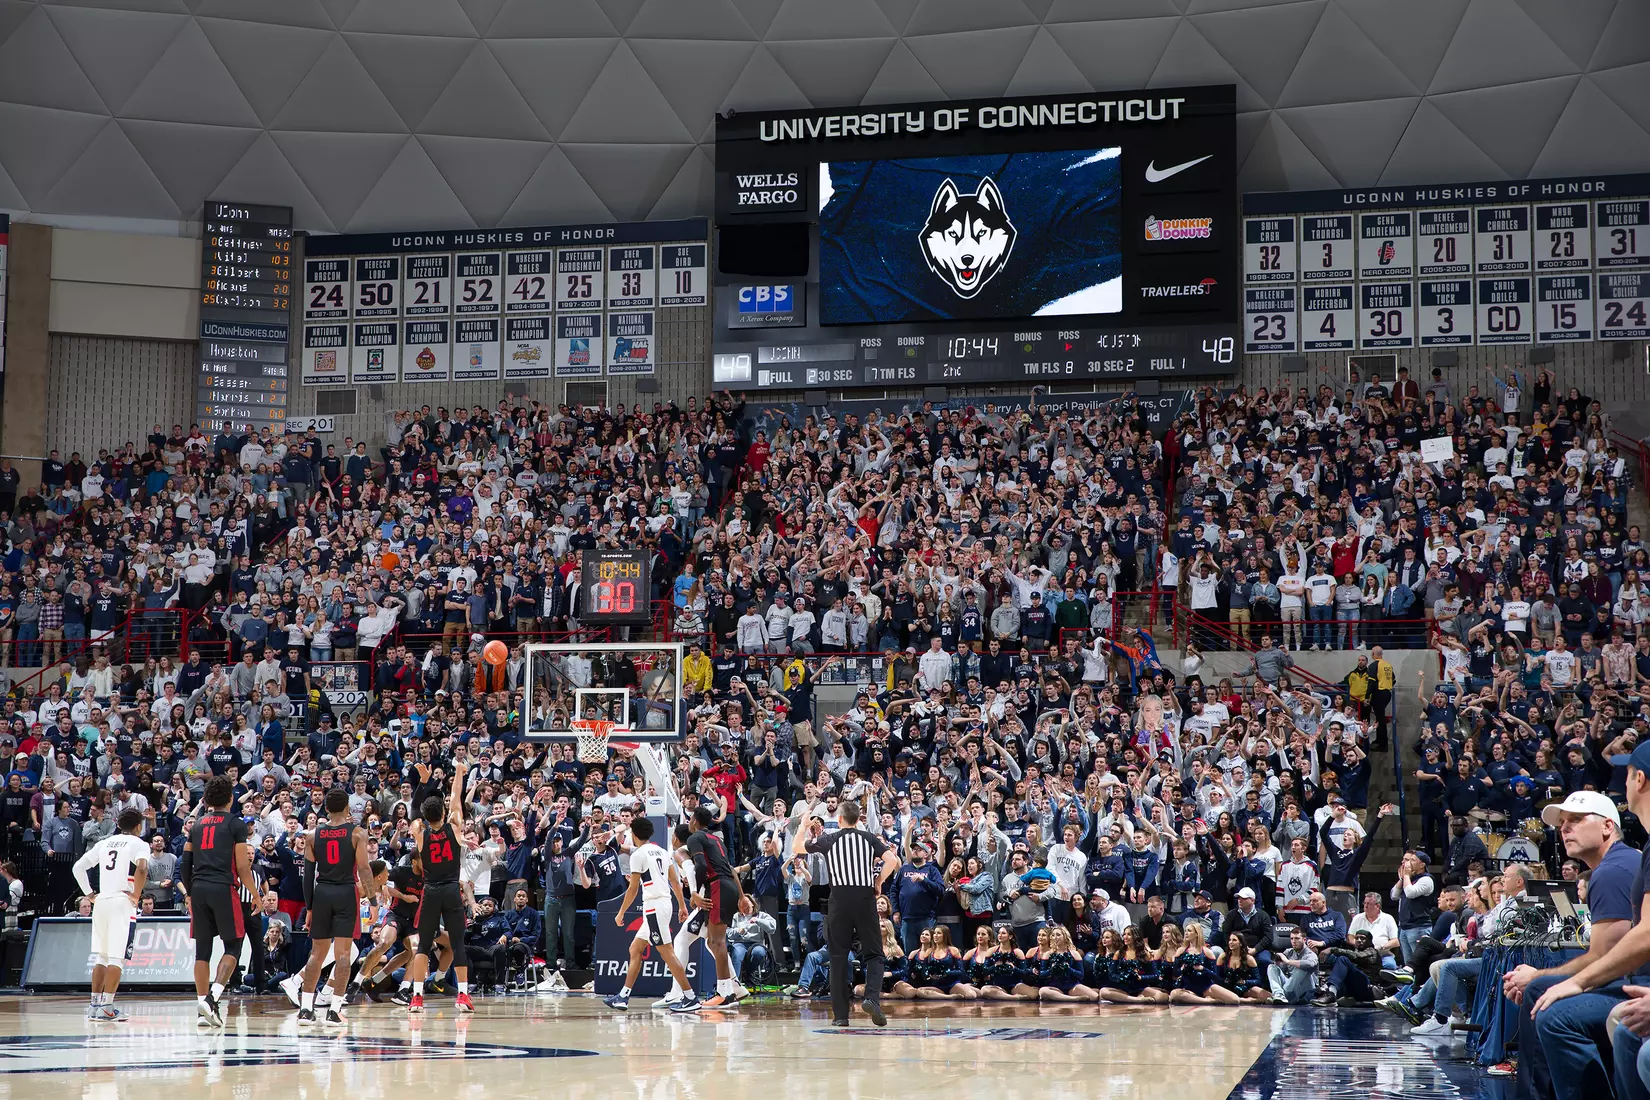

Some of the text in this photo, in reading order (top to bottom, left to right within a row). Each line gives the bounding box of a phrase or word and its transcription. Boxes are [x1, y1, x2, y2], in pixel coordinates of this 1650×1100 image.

[759, 98, 1186, 142] UNIVERSITY OF CONNECTICUT
[737, 173, 798, 187] WELLS
[738, 191, 797, 205] FARGO
[1344, 181, 1606, 204] UCONN HUSKIES OF HONOR
[1606, 204, 1640, 213] STEFANIE
[1433, 213, 1454, 222] RENEE
[1494, 210, 1511, 219] TINA
[1609, 214, 1638, 225] DOLSON
[1163, 218, 1212, 229] DUNKIN'
[1261, 222, 1278, 230] SWIN
[1317, 219, 1337, 228] DIANA
[1377, 216, 1394, 225] GENO
[1487, 220, 1518, 230] CHARLES
[1550, 217, 1574, 228] MOORE
[1164, 228, 1209, 238] DONUTS
[1366, 226, 1405, 236] AURIEMMA
[1421, 222, 1468, 234] MONTGOMERY
[393, 228, 615, 246] UCONN HUSKIES OF HONOR
[1260, 231, 1280, 241] CASH
[1311, 229, 1343, 239] TAURASI
[1493, 234, 1513, 260] 31
[1551, 232, 1574, 257] 23
[1610, 229, 1635, 255] 31
[678, 248, 689, 256] SUE
[1322, 243, 1332, 267] 3
[1434, 237, 1455, 262] 20
[566, 252, 595, 261] SVETLANA
[676, 257, 691, 266] BIRD
[1260, 246, 1280, 270] 32
[365, 260, 391, 268] REBECCA
[414, 258, 443, 267] JENNIFER
[560, 261, 600, 271] ABROSIMOVA
[621, 260, 642, 269] RALPH
[369, 269, 385, 279] LOBO
[413, 267, 443, 277] RIZZOTTI
[464, 266, 493, 275] WOLTERS
[519, 264, 539, 273] SALES
[314, 271, 341, 281] BASCOM
[1609, 275, 1641, 286] NAPHEESA
[568, 275, 592, 298] 25
[622, 273, 641, 296] 33
[675, 271, 691, 294] 10
[1432, 283, 1459, 292] MORGAN
[1494, 281, 1515, 290] CHRIS
[414, 281, 441, 304] 21
[463, 279, 492, 302] 52
[512, 277, 545, 300] 42
[739, 285, 789, 302] CBS
[1141, 285, 1204, 297] TRAVELERS
[1315, 289, 1340, 298] MORIAH
[1371, 286, 1402, 295] BREANNA
[1546, 289, 1582, 299] WILLIAMS
[1613, 287, 1637, 297] COLLIER
[310, 285, 343, 308] 24
[360, 283, 393, 306] 50
[1256, 290, 1284, 299] KALEENA
[1436, 294, 1455, 304] TUCK
[1491, 291, 1517, 302] DAILEY
[1308, 299, 1348, 309] JEFFERSON
[1369, 297, 1403, 307] STEWART
[618, 315, 644, 324] NATIONAL
[765, 315, 794, 323] Company
[1488, 306, 1520, 332] CD
[1551, 303, 1576, 329] 15
[1604, 301, 1646, 327] 24
[513, 320, 542, 328] NATIONAL
[567, 317, 592, 326] NATIONAL
[1320, 313, 1335, 337] 4
[1370, 310, 1402, 337] 30
[1437, 308, 1453, 333] 3
[313, 327, 339, 336] NATIONAL
[363, 325, 390, 334] NATIONAL
[413, 323, 440, 332] NATIONAL
[462, 322, 491, 331] NATIONAL
[565, 327, 593, 337] CHAMPION
[617, 325, 645, 335] CHAMPION
[1254, 315, 1286, 340] 23
[360, 334, 392, 344] CHAMPION
[411, 333, 443, 343] CHAMPION
[461, 331, 493, 341] CHAMPION
[511, 329, 544, 339] CHAMPION
[1014, 331, 1080, 342] BONUS POSS
[310, 336, 342, 346] CHAMPION
[861, 337, 924, 347] POSS BONUS
[947, 338, 998, 358] 10:44
[1202, 336, 1234, 364] 48
[720, 356, 750, 378] 49
[1024, 361, 1073, 374] TM FLS 8
[1088, 359, 1134, 372] 30 SEC 2
[1151, 358, 1185, 370] FULL 1
[770, 372, 792, 383] FULL
[818, 371, 831, 381] 30
[833, 370, 852, 381] SEC
[871, 367, 915, 380] 7 TM FLS
[1160, 399, 1174, 408] CT
[287, 418, 334, 429] SEC 201
[598, 562, 640, 577] 10:44
[598, 582, 635, 612] 30
[964, 618, 975, 627] 34
[941, 627, 952, 635] 24
[337, 692, 366, 703] 202
[201, 826, 216, 849] 11
[320, 829, 348, 839] SASSER
[327, 840, 339, 864] 0
[430, 840, 454, 863] 24
[106, 850, 118, 870] 3
[1056, 857, 1080, 870] UCONN
[603, 862, 617, 875] 34
[656, 858, 664, 875] 0
[1309, 920, 1334, 928] UCONN
[596, 960, 697, 977] TRAELES
